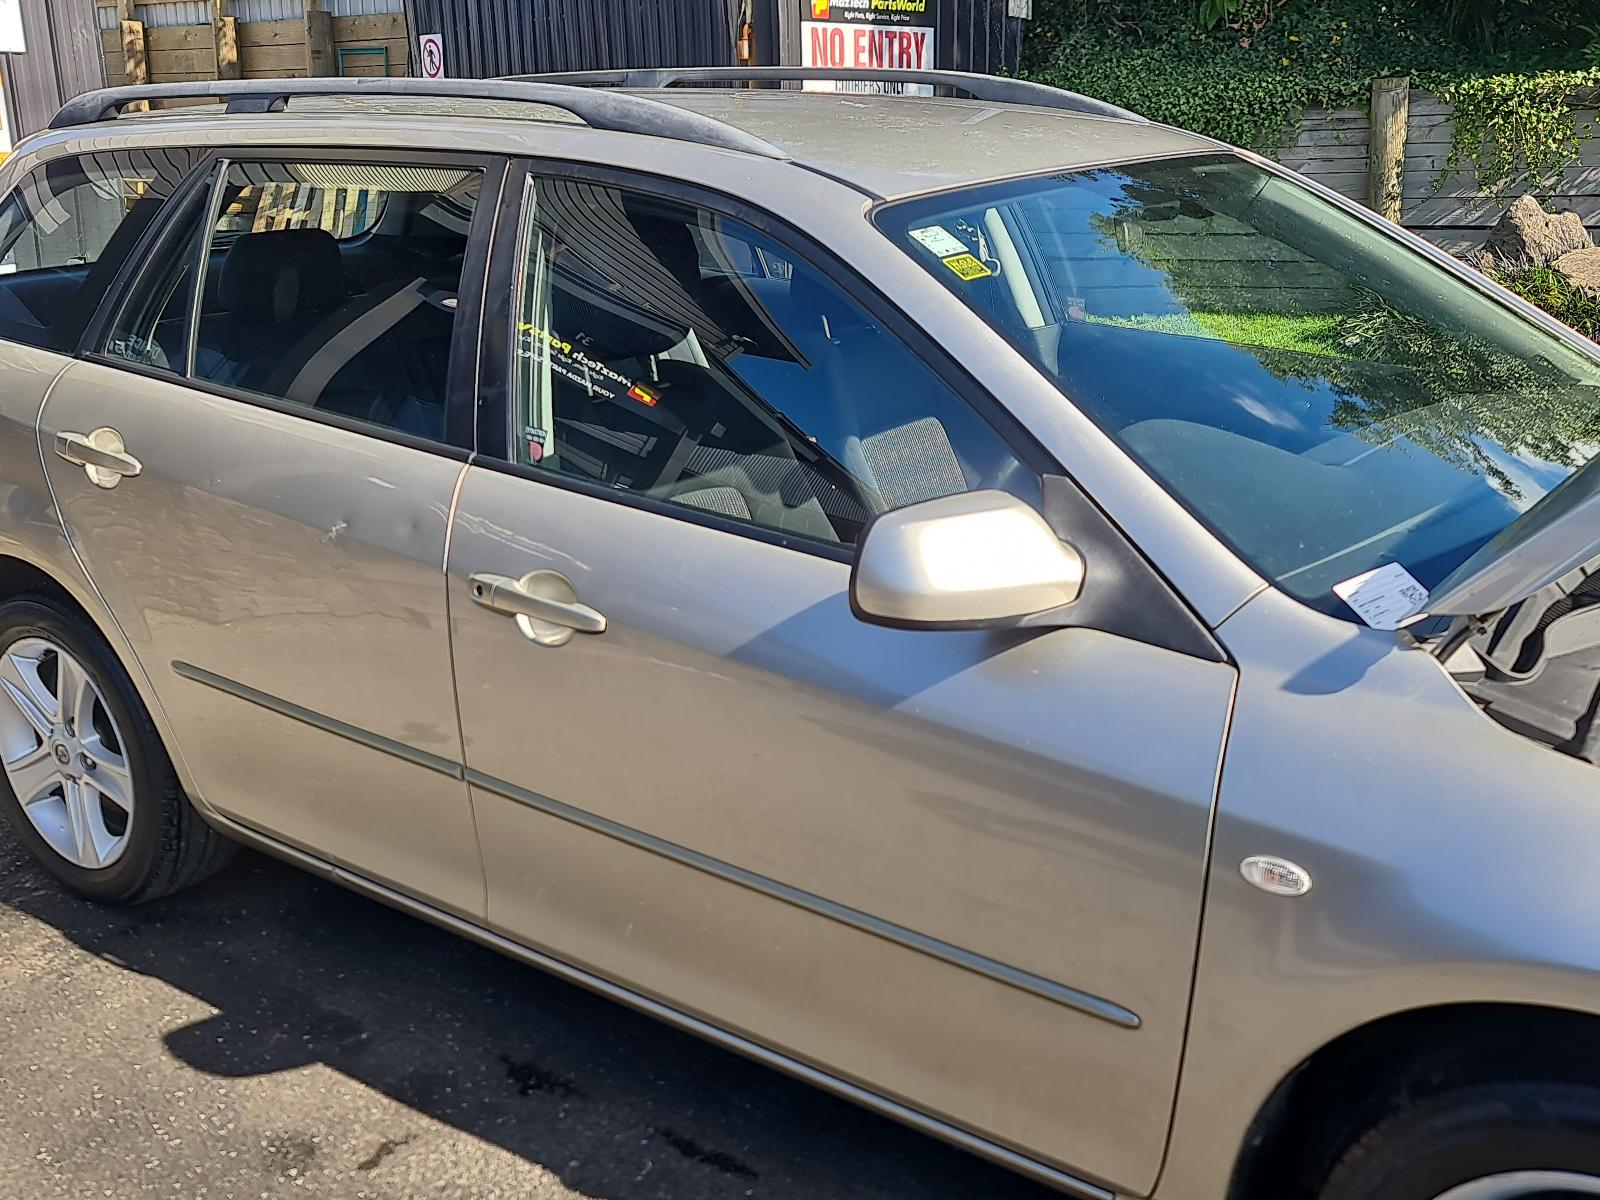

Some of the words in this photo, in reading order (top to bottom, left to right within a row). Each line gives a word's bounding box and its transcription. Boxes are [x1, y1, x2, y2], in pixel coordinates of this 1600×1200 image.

[871, 0, 925, 12] PartsWorld
[811, 27, 845, 68] NO
[853, 29, 926, 70] ENTRY
[883, 81, 904, 95] ONLY
